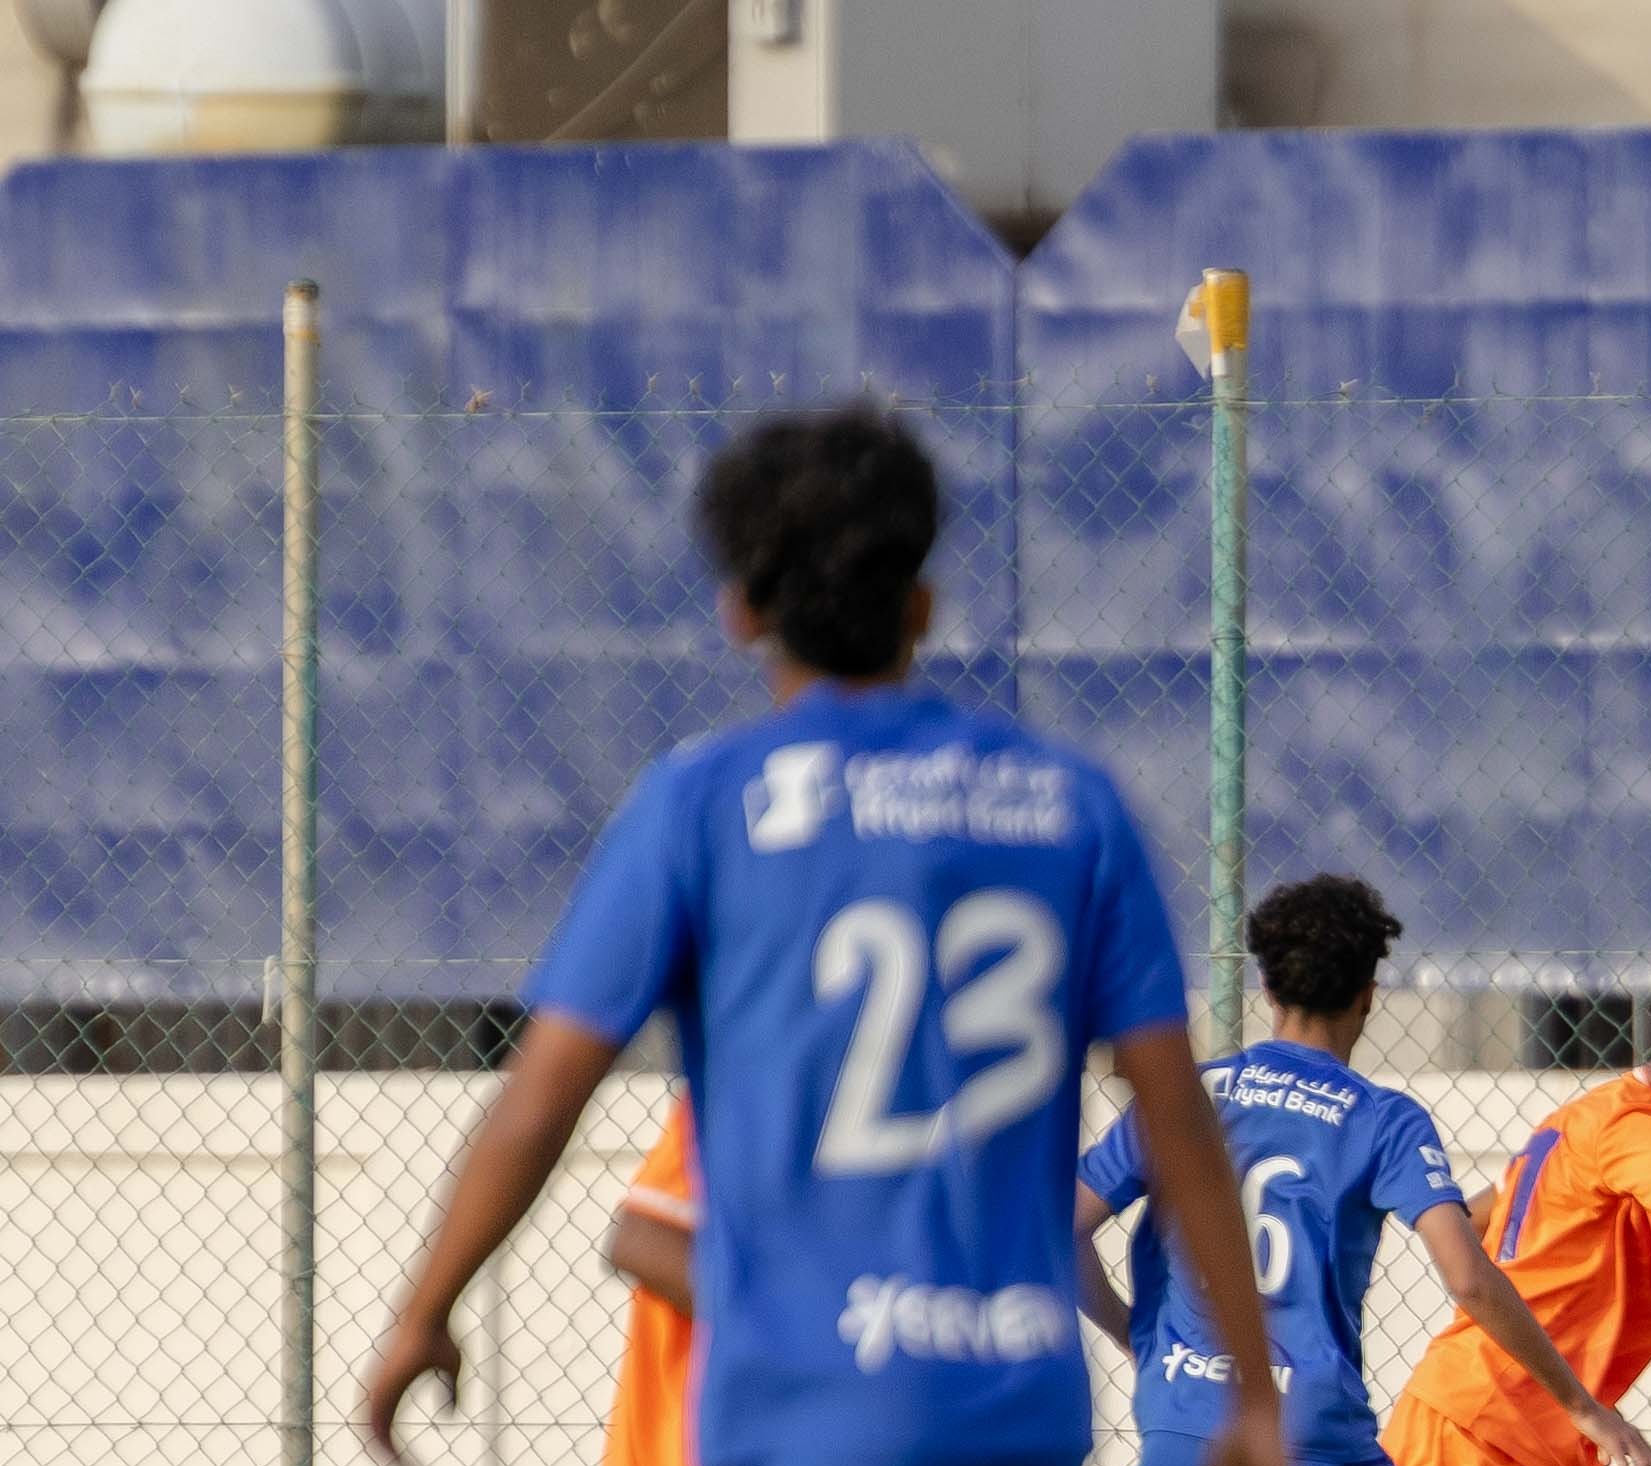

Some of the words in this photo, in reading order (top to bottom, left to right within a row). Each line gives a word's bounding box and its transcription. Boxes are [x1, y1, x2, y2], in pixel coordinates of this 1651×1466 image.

[812, 887, 1067, 1177] 23
[1230, 1083, 1285, 1107] iyad
[1284, 1090, 1345, 1127] Bank
